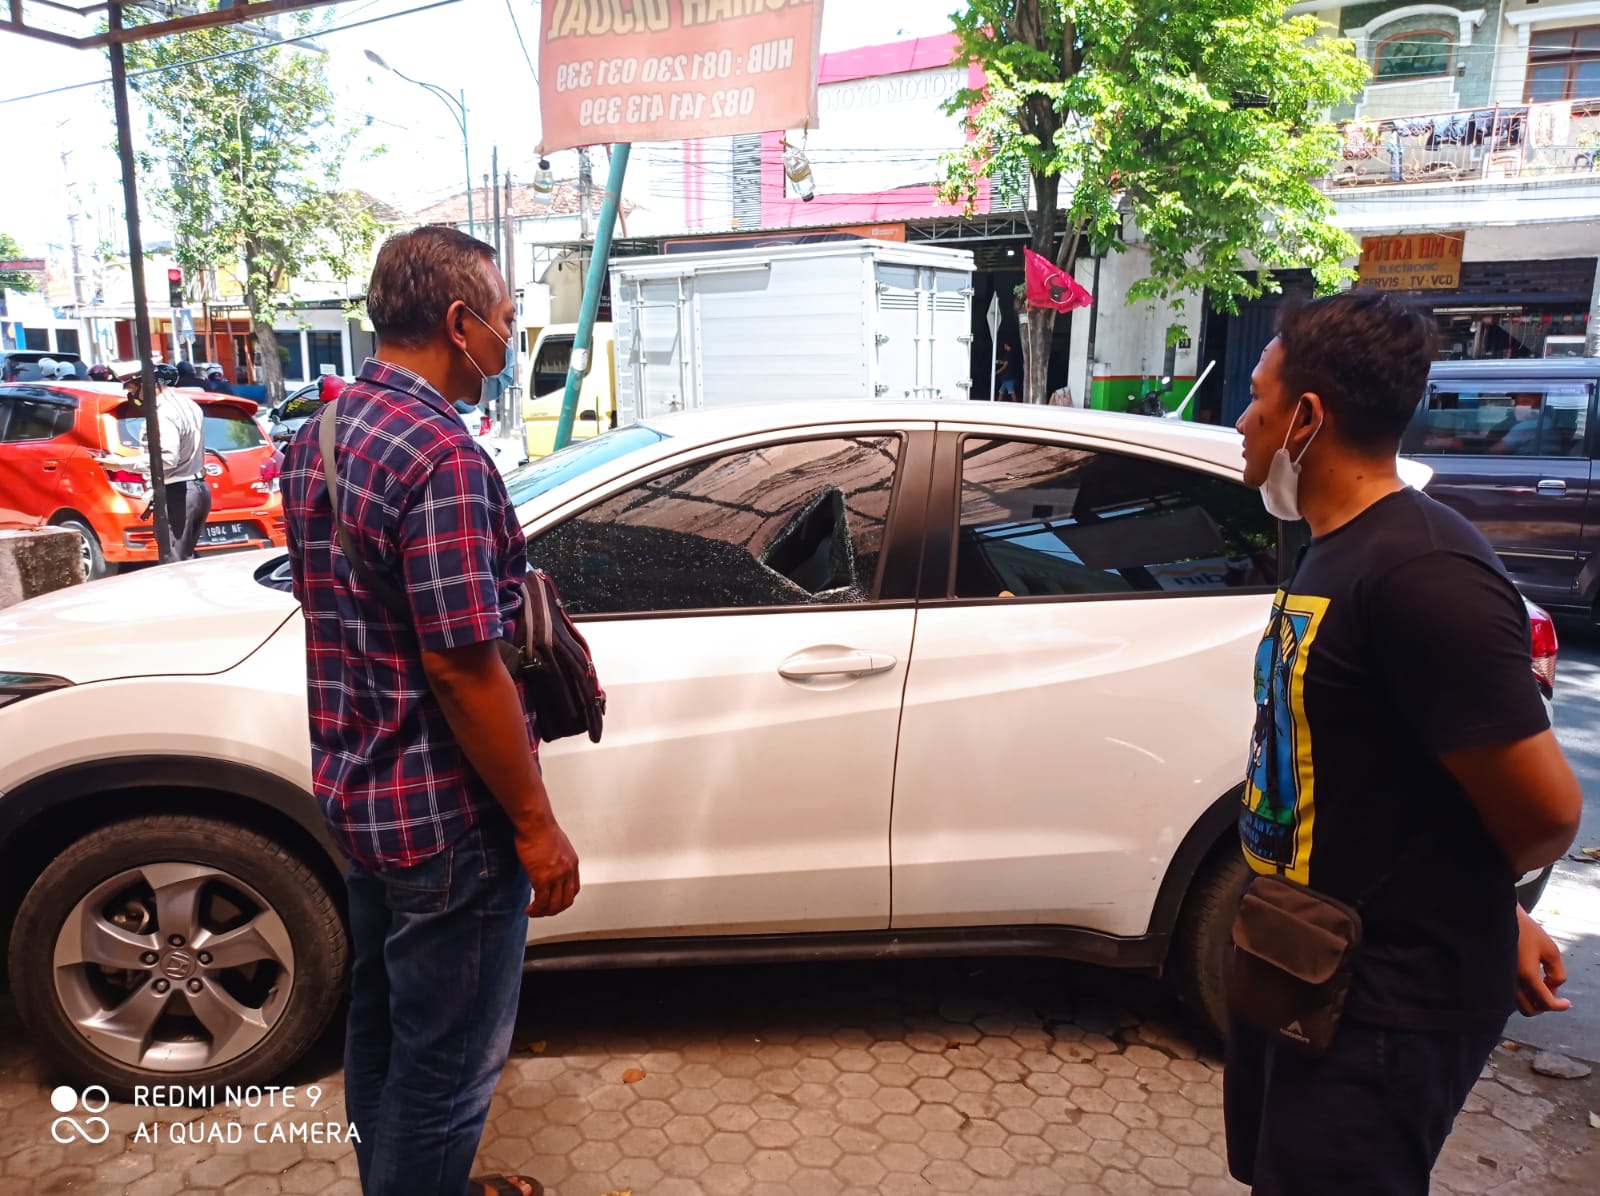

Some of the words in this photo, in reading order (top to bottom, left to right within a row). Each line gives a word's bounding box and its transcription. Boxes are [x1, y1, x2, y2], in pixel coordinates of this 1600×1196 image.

[885, 72, 960, 104] MOTOR
[1366, 238, 1412, 260] PUTRA
[1379, 263, 1437, 273] ELECTRONIC
[1362, 277, 1400, 288] SERVIS
[1410, 275, 1425, 286] TV
